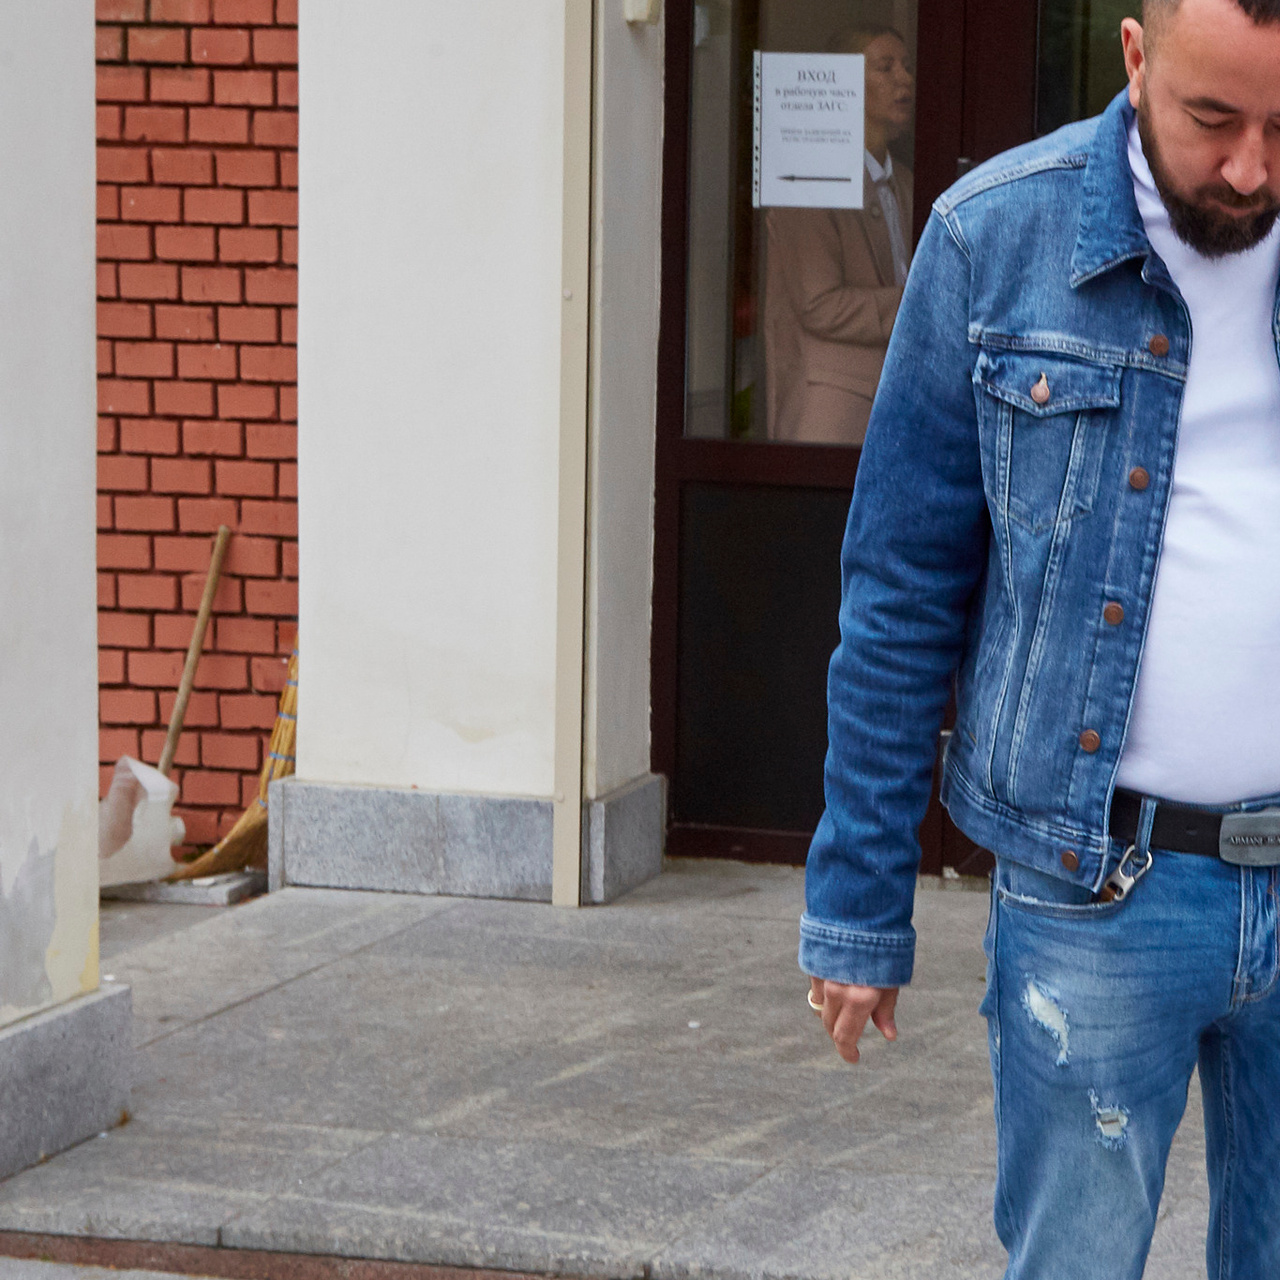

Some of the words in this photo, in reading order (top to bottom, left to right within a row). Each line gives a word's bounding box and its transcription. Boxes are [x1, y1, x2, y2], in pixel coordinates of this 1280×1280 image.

[797, 69, 836, 83] ВХОД
[783, 85, 827, 98] рабочую
[829, 88, 857, 98] часть
[779, 101, 814, 111] отдела
